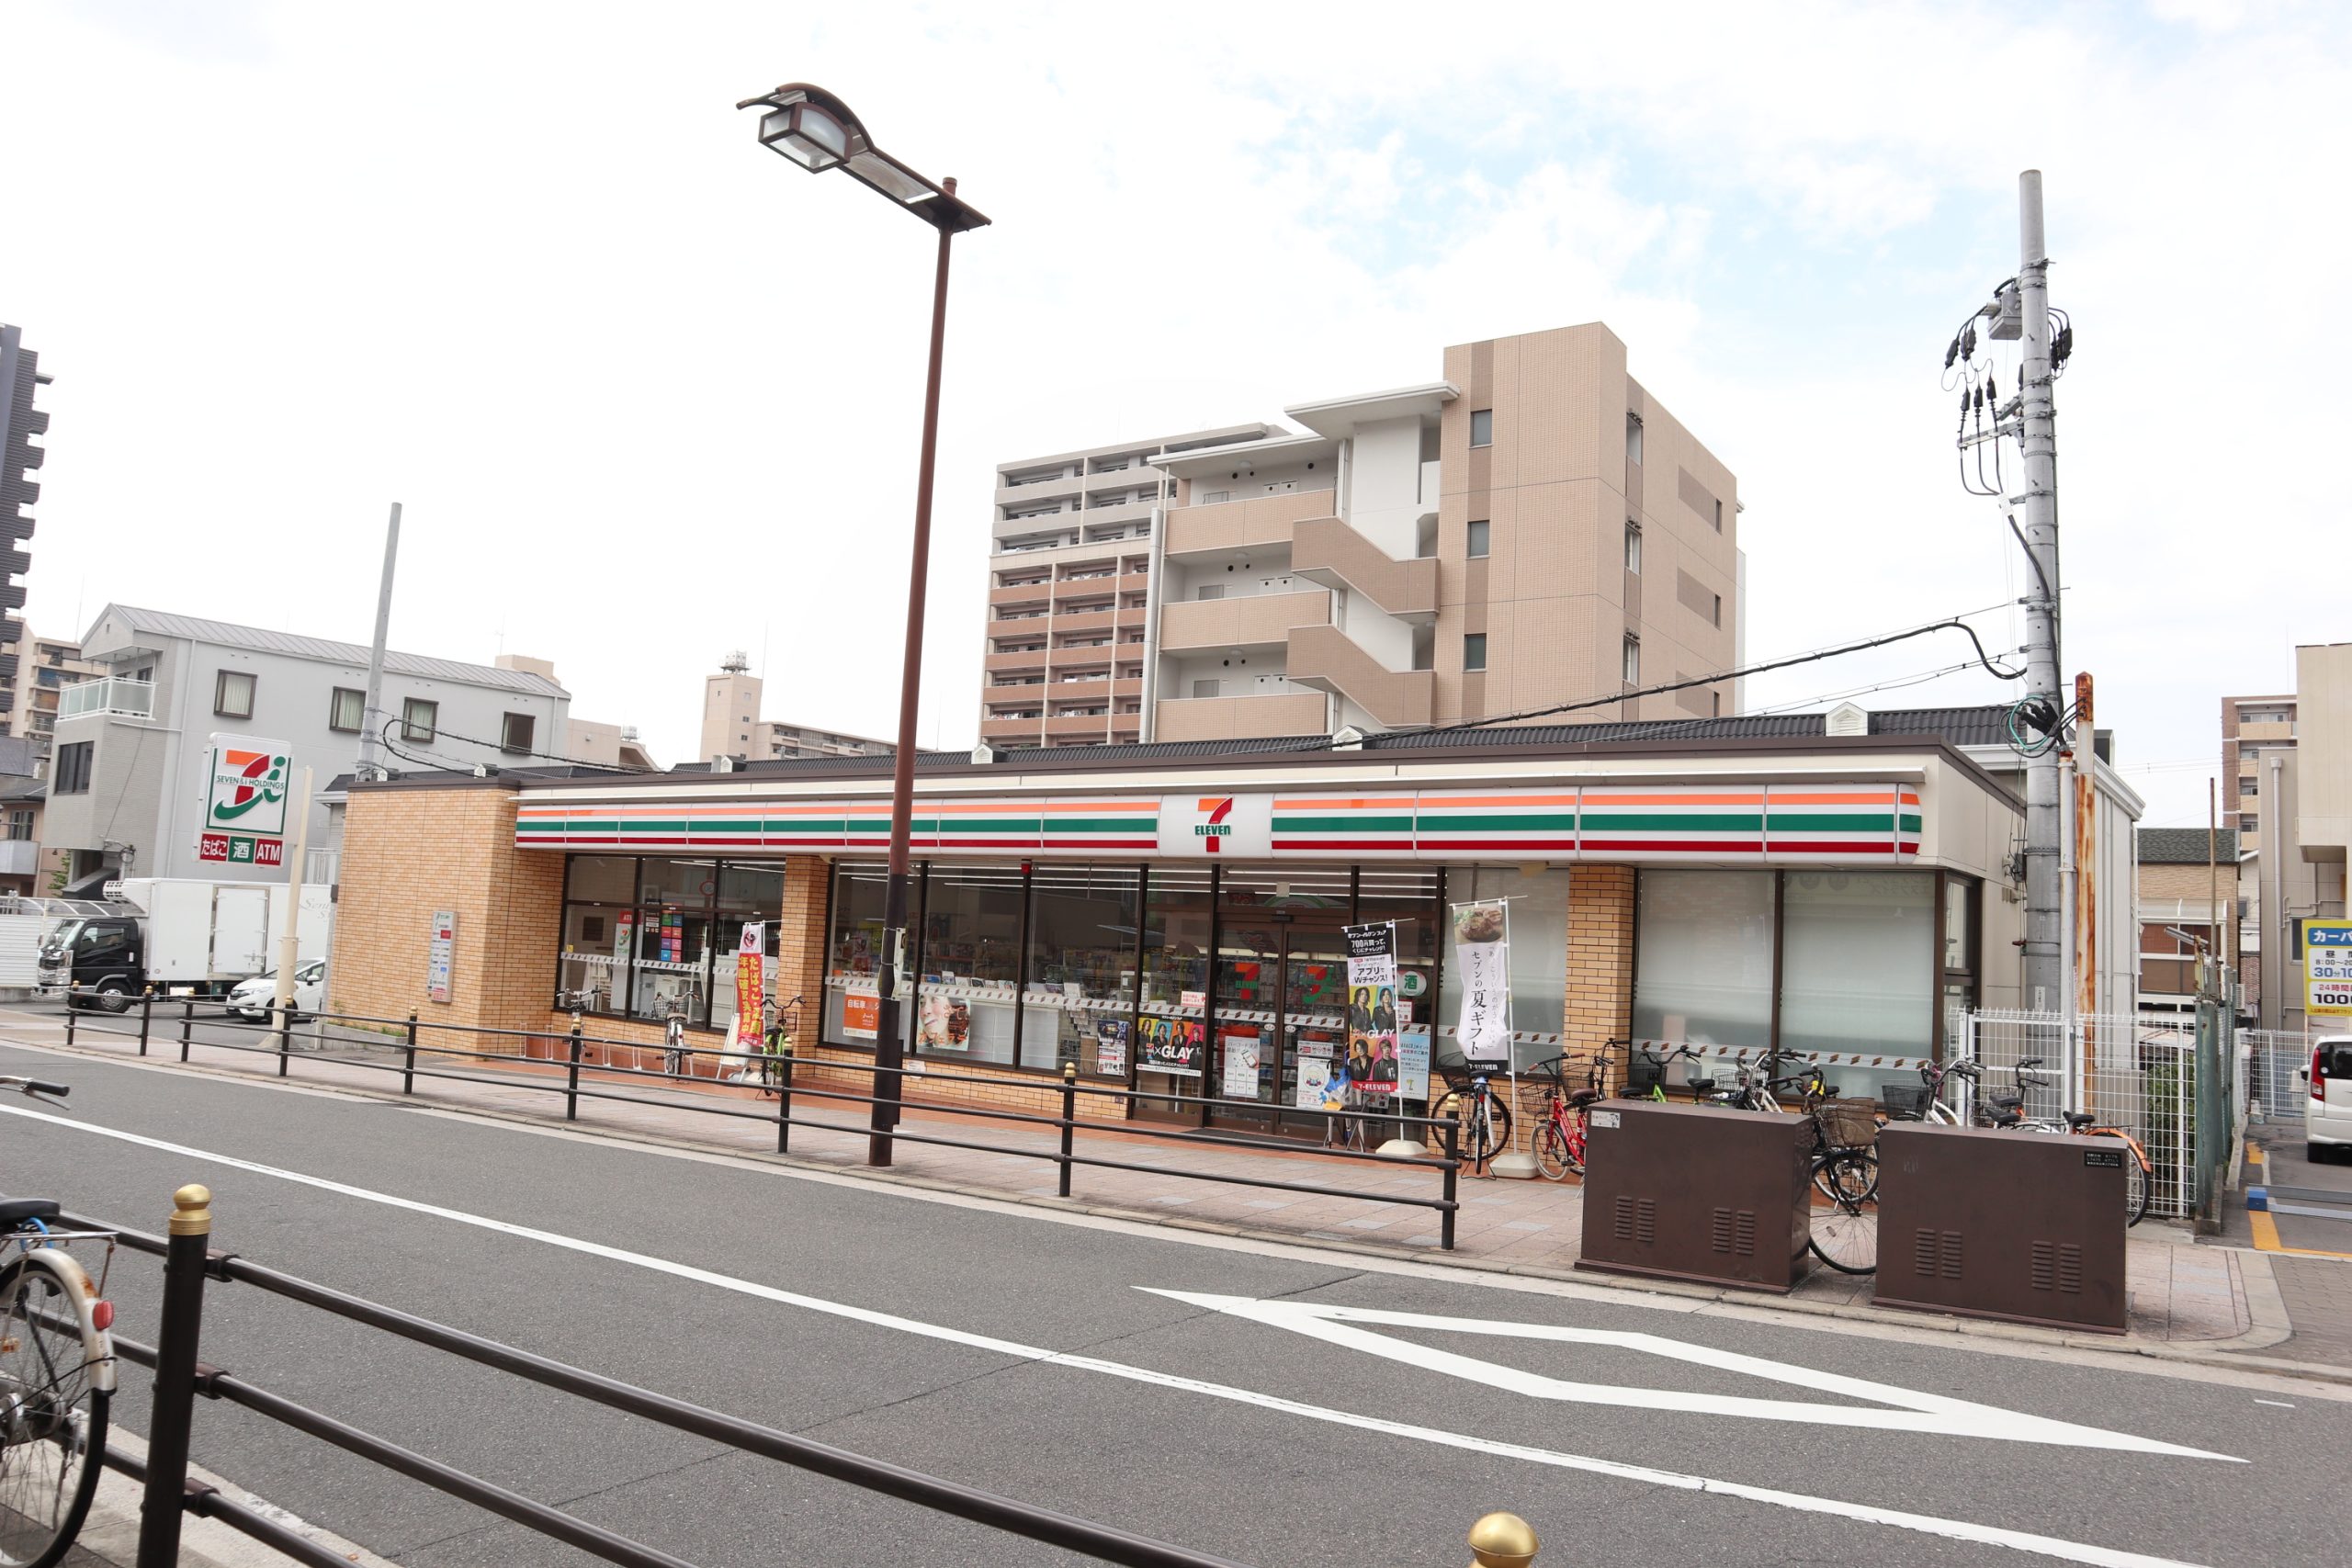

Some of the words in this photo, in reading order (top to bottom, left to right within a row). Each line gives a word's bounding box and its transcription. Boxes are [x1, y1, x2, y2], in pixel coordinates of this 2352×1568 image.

[249, 779, 285, 790] HOLDINGS
[200, 839, 227, 857] たばこ
[232, 841, 251, 859] 酒
[256, 843, 281, 862] ATM
[1404, 975, 1418, 989] 酒
[1470, 951, 1487, 1055] セブンの夏ギフト
[2313, 994, 2352, 1005] 100
